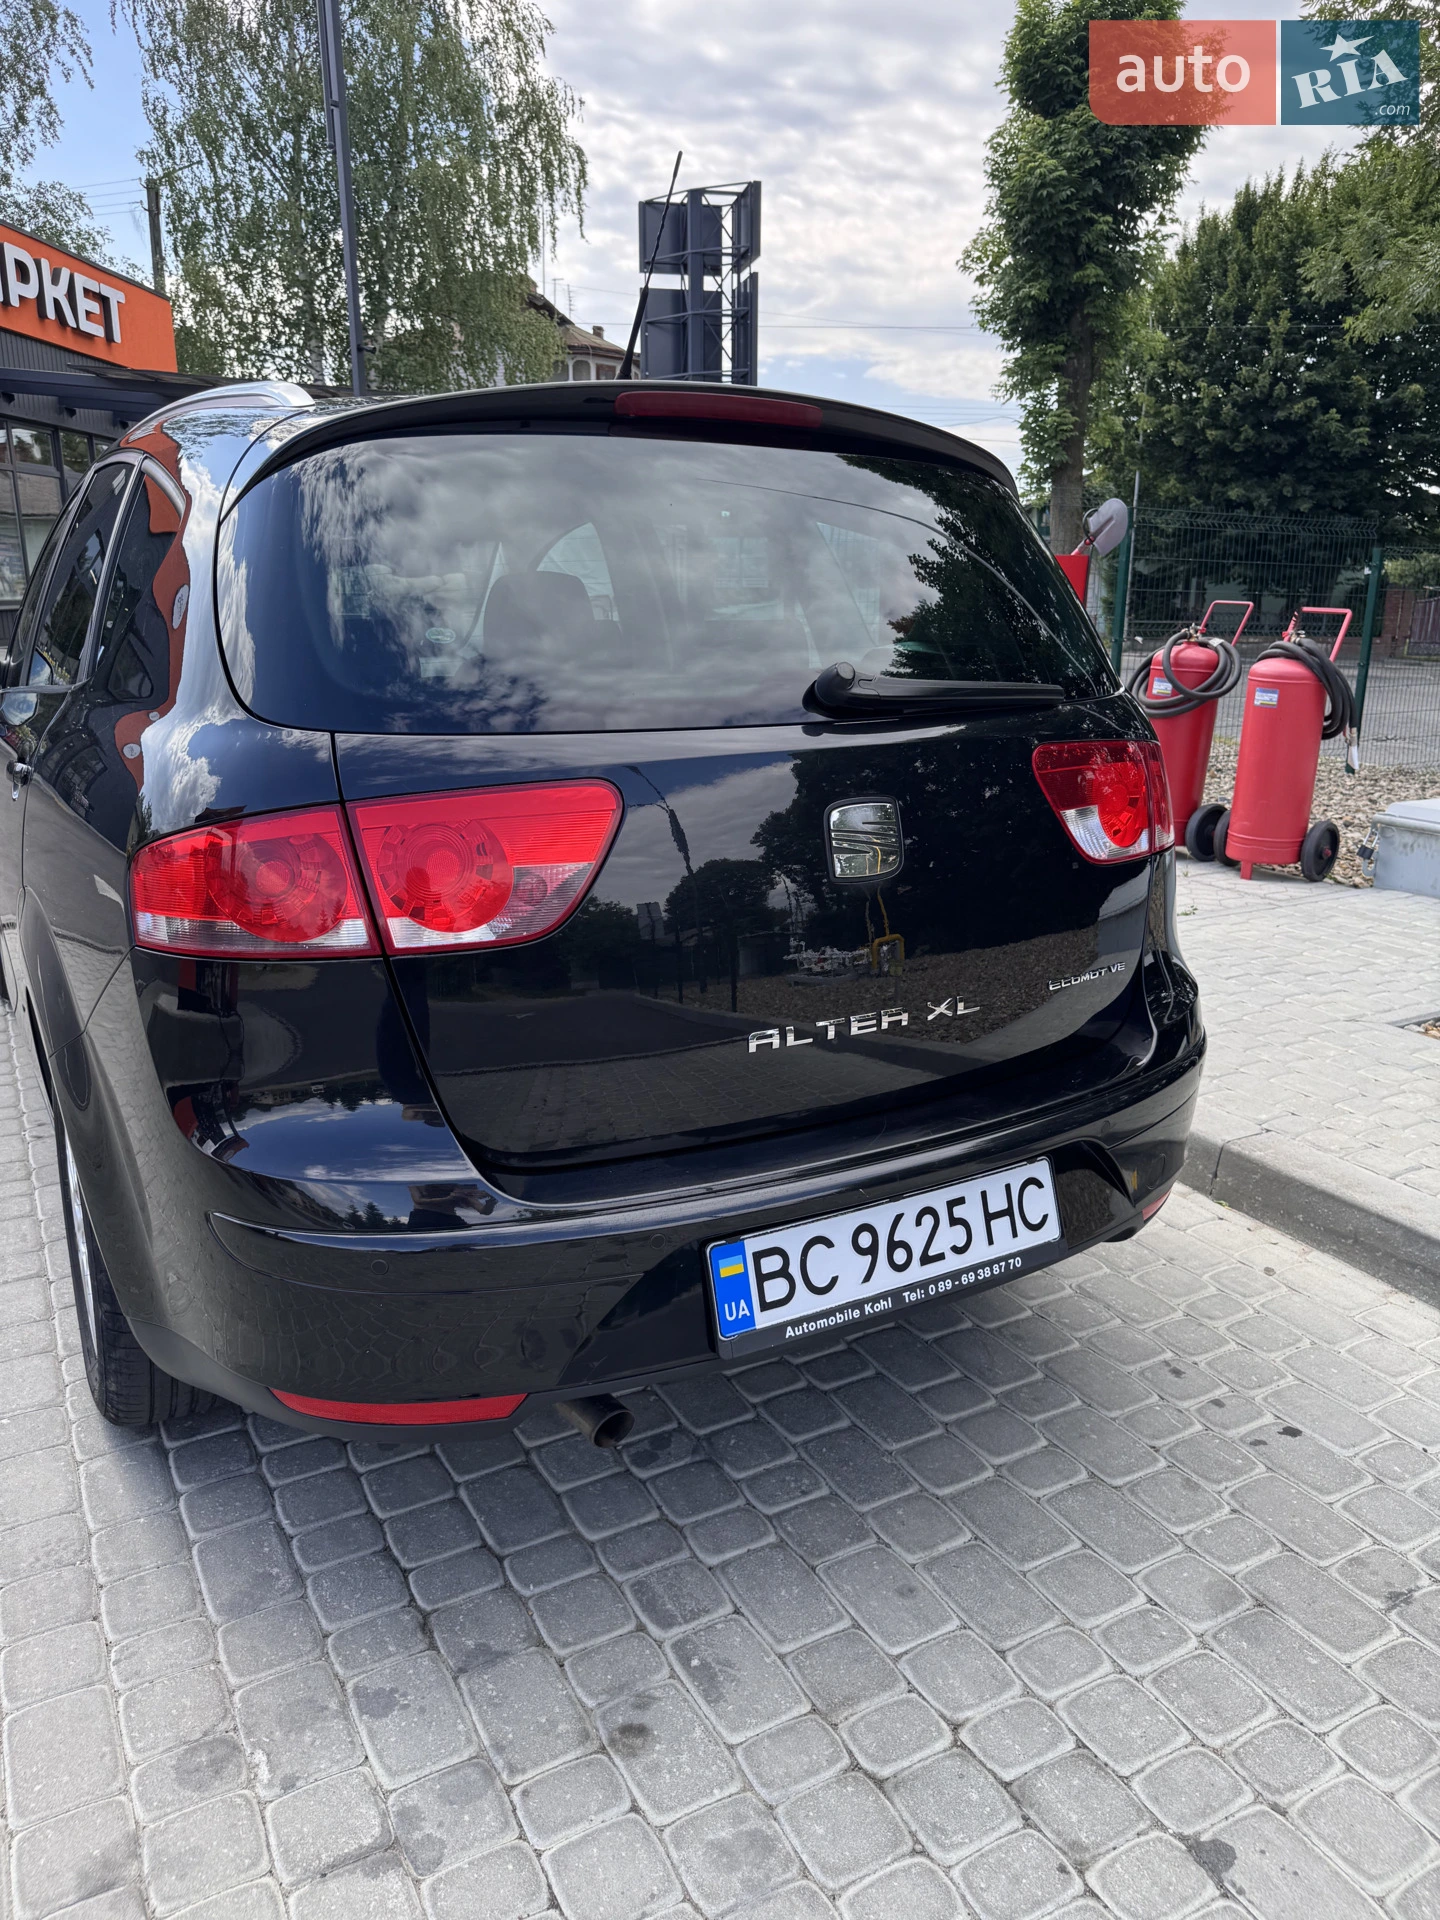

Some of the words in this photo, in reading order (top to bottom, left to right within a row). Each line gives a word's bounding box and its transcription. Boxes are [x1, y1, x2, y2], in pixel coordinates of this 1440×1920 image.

[0, 241, 126, 344] РКЕТ
[748, 1007, 909, 1053] ALTEA
[926, 995, 981, 1021] XL
[752, 1235, 839, 1313] BC
[851, 1195, 973, 1285] 9625
[980, 1176, 1049, 1247] HC
[723, 1298, 751, 1322] UA
[785, 1308, 861, 1339] Automobile
[864, 1297, 892, 1316] Kohl
[902, 1288, 925, 1303] Tel:
